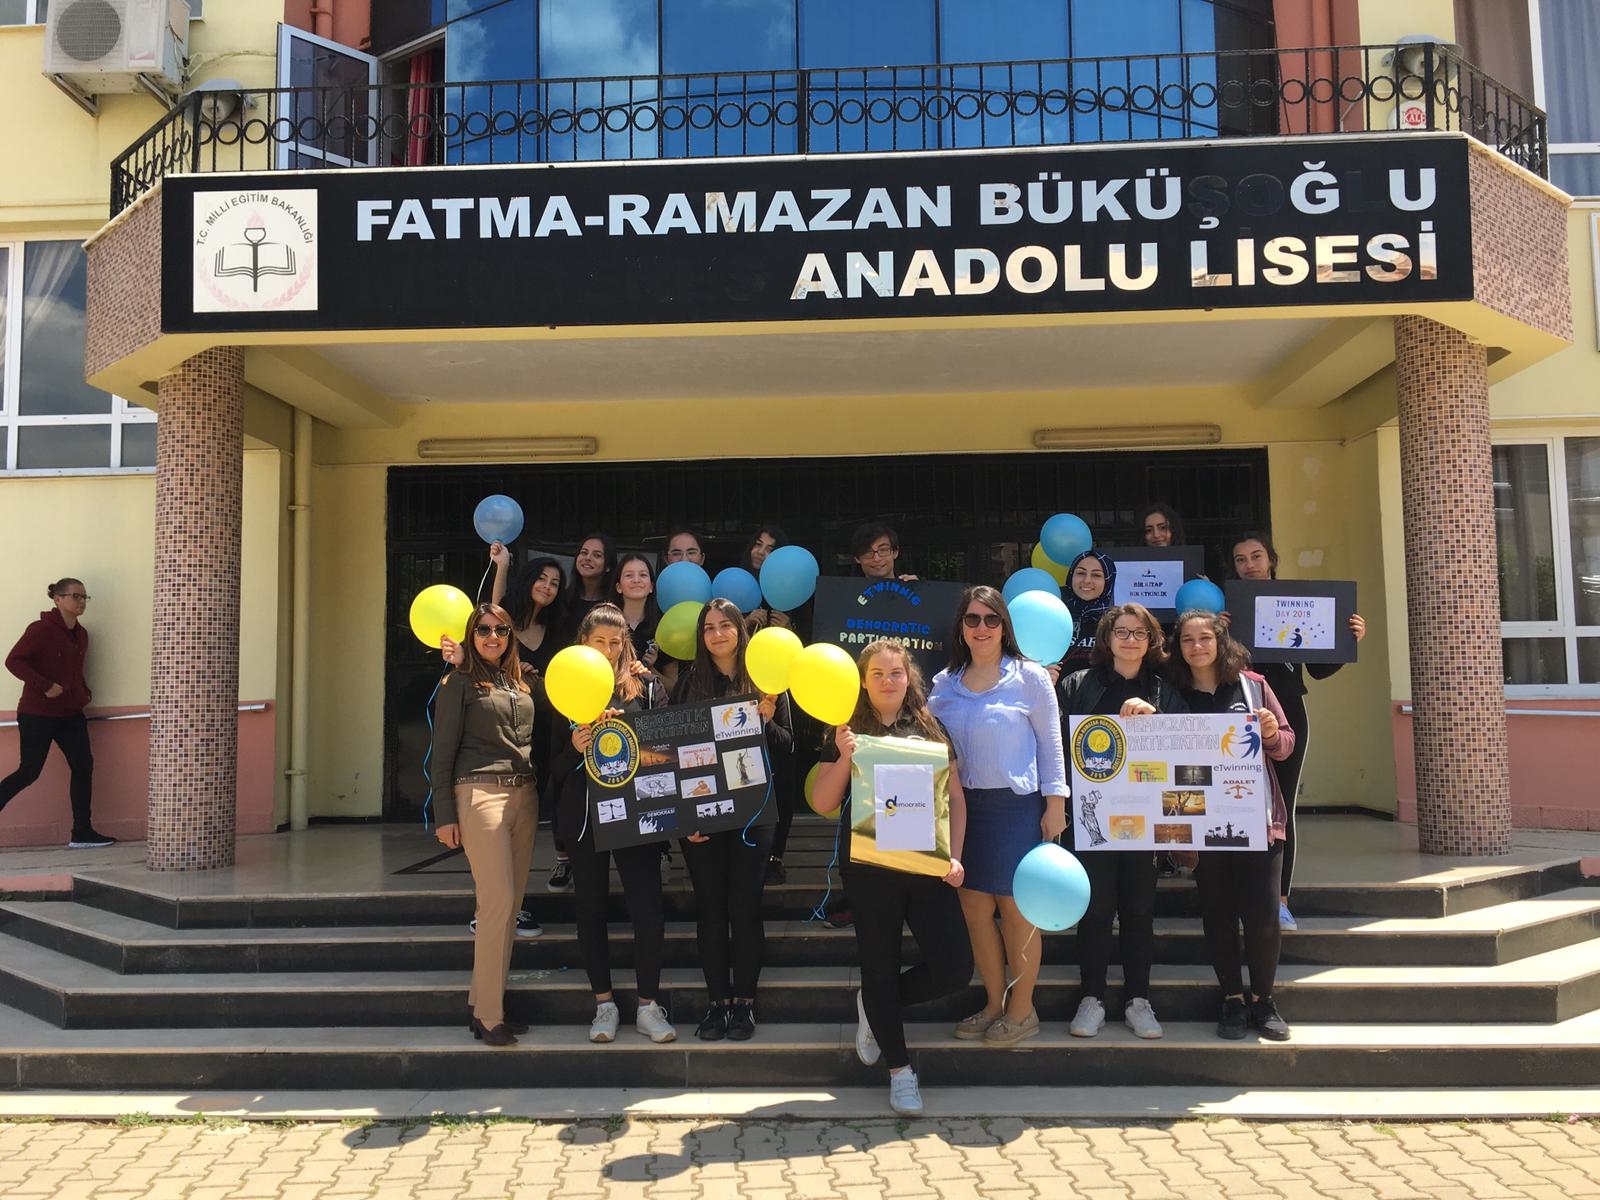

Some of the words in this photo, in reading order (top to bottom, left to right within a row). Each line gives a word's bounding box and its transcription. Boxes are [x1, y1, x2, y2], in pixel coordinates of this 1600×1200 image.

[196, 228, 210, 245] T.C.
[205, 201, 231, 226] MİLLİ
[231, 192, 269, 207] EĞİTİM
[271, 196, 313, 243] BAKANLIĞI
[356, 186, 952, 242] FATMA-RAMAZAN
[791, 242, 1158, 299] ANADOLU
[1275, 610, 1290, 618] DAY
[1293, 610, 1311, 618] 2018
[846, 618, 931, 635] DEMOCRATIC
[715, 726, 760, 739] eTwinning
[1214, 763, 1262, 773] eTwinning
[885, 795, 926, 809] democratic
